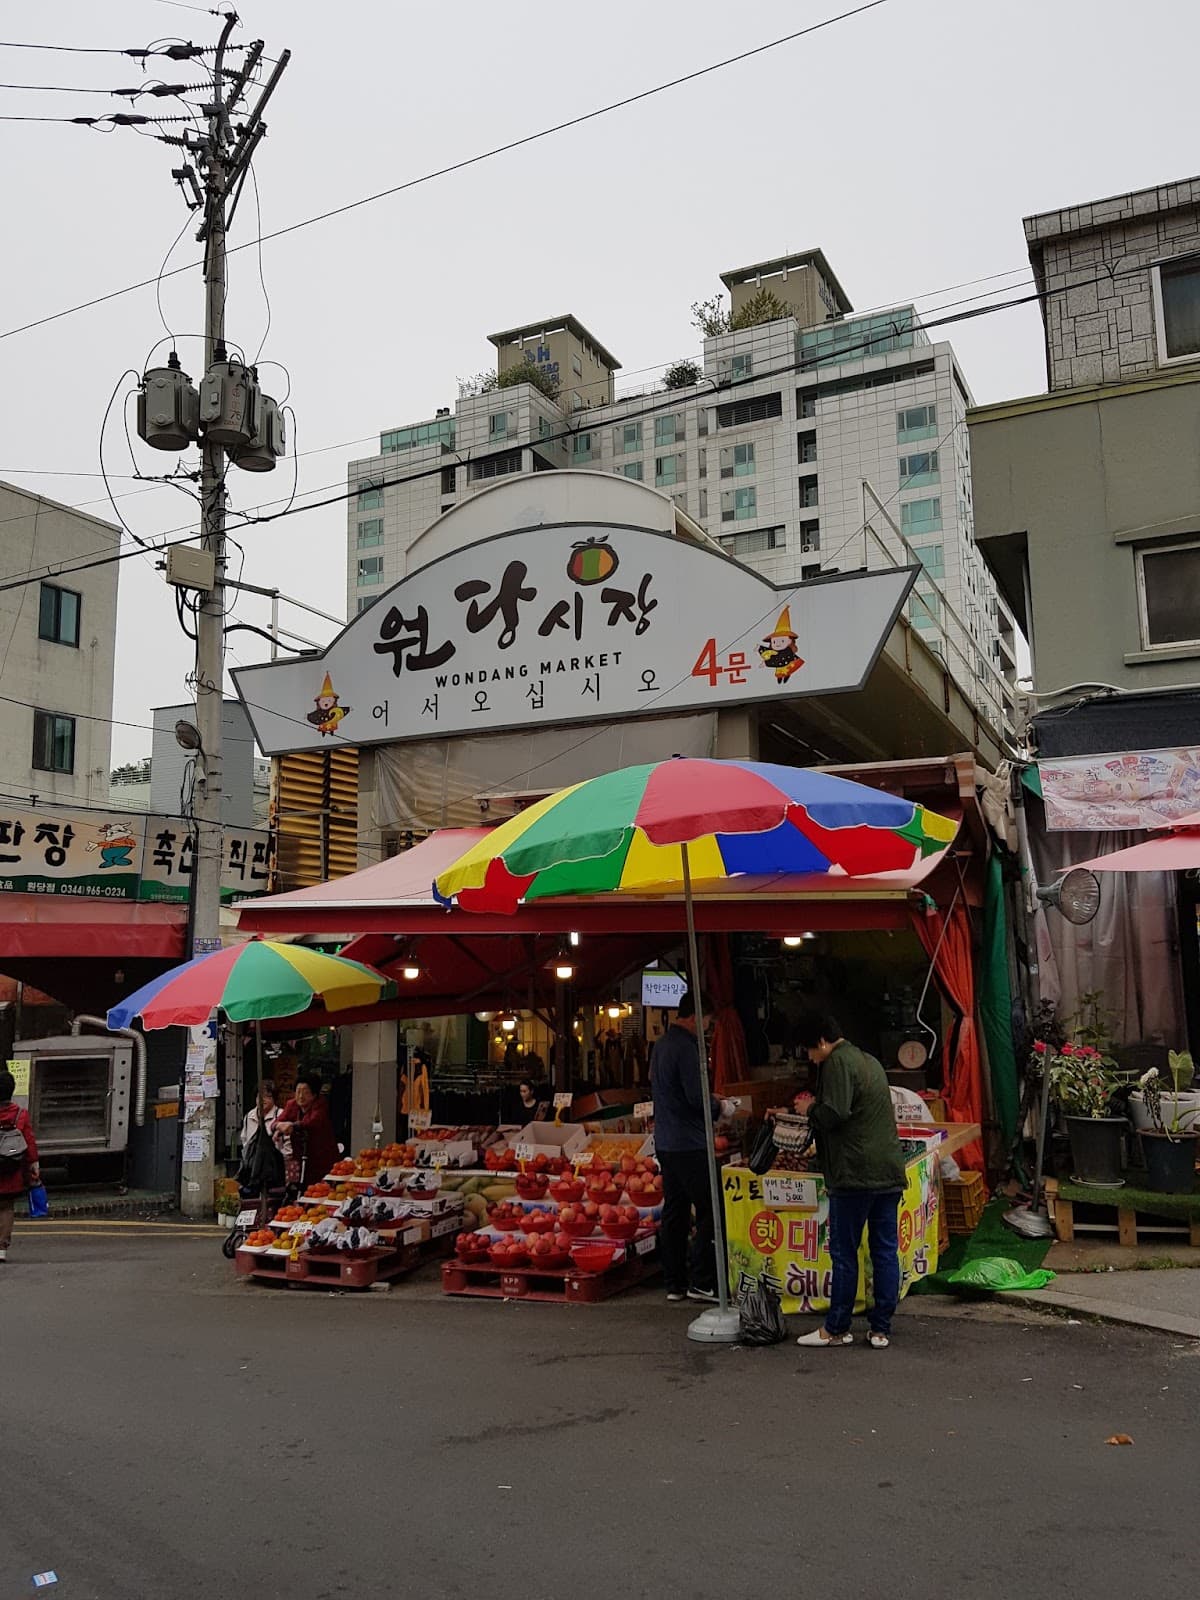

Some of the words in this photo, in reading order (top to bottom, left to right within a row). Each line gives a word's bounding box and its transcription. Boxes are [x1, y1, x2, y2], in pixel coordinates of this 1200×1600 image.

[373, 560, 658, 678] 원당시장
[435, 664, 529, 689] WONDANG
[540, 651, 622, 675] MARKET
[691, 638, 751, 686] 4문
[755, 1218, 778, 1250] 햇
